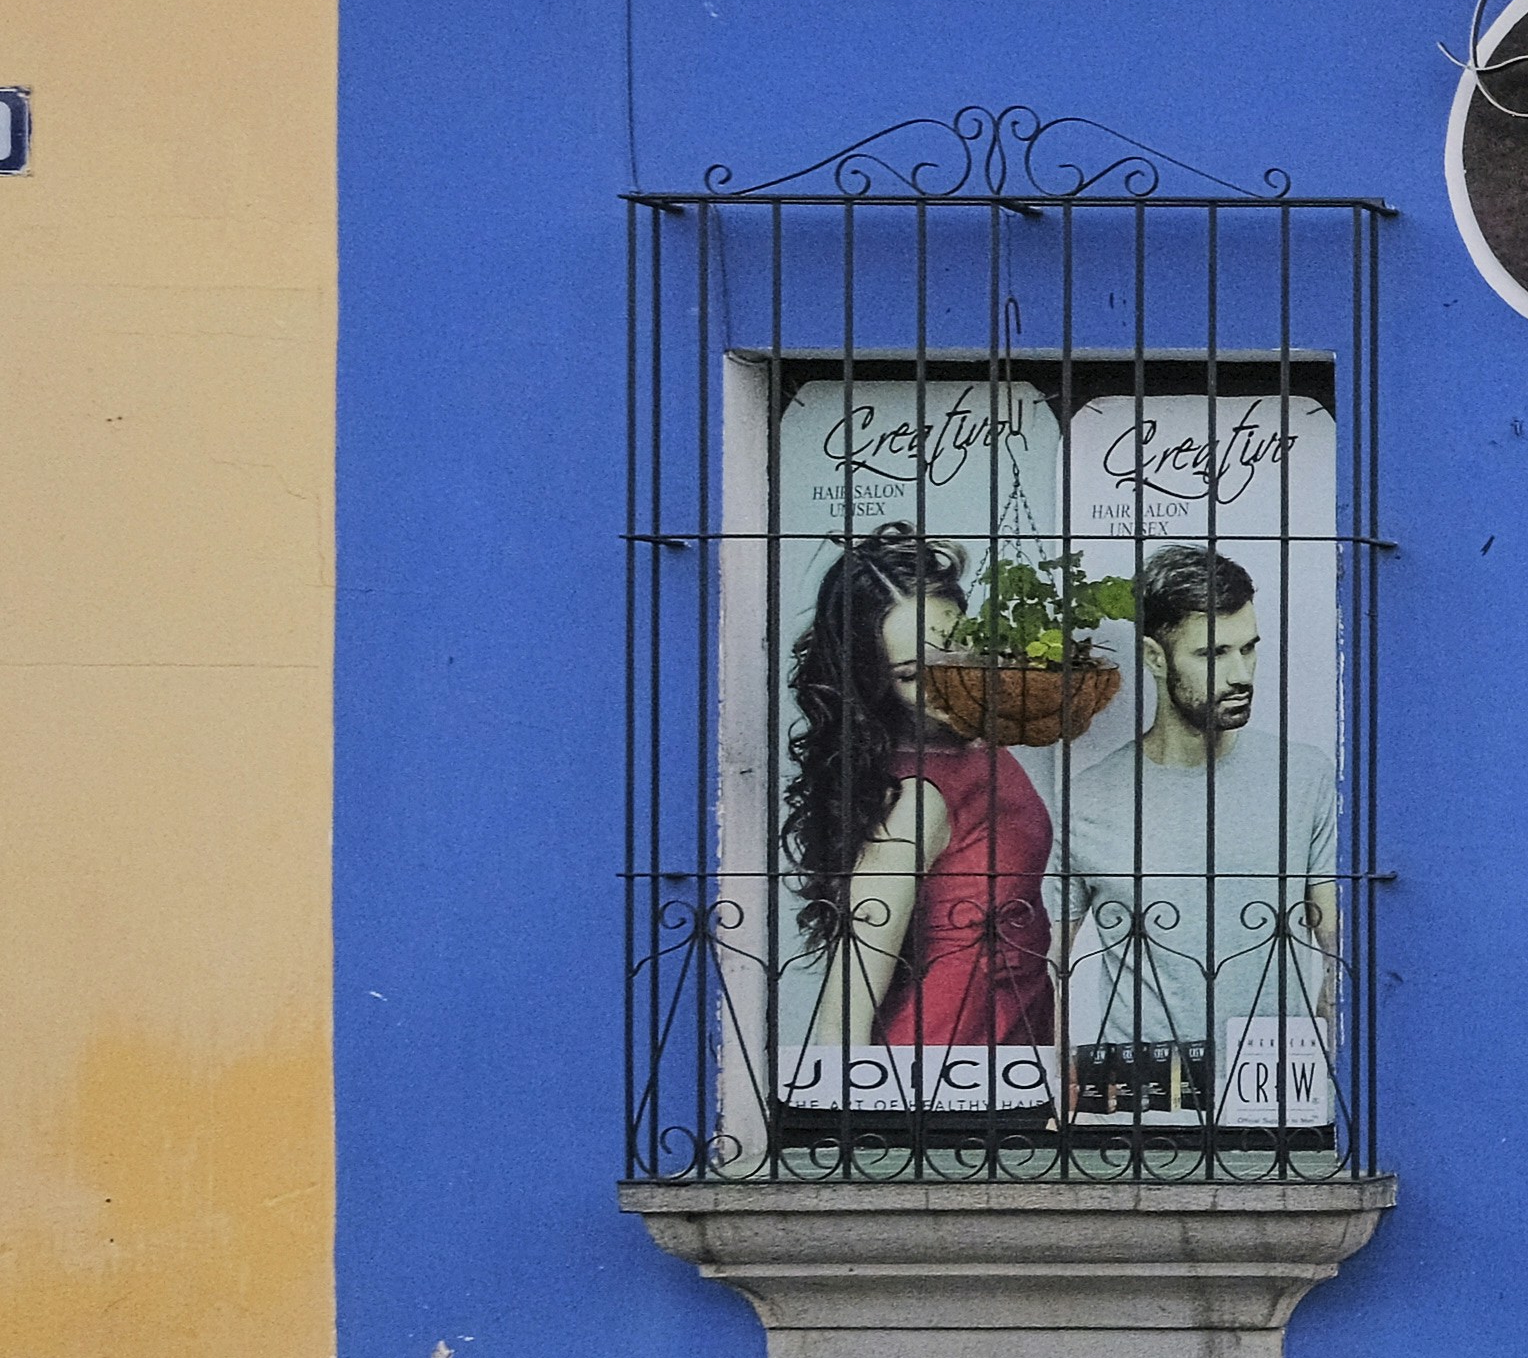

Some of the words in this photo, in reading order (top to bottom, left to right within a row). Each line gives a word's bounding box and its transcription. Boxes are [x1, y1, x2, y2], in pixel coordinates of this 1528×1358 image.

[1103, 399, 1299, 504] Creativo
[854, 483, 905, 500] SALON
[1092, 503, 1131, 519] HAIR
[1137, 502, 1190, 518] ALON
[1110, 521, 1169, 537] UNSEX
[786, 1099, 820, 1109] HE
[830, 1100, 864, 1110] AT
